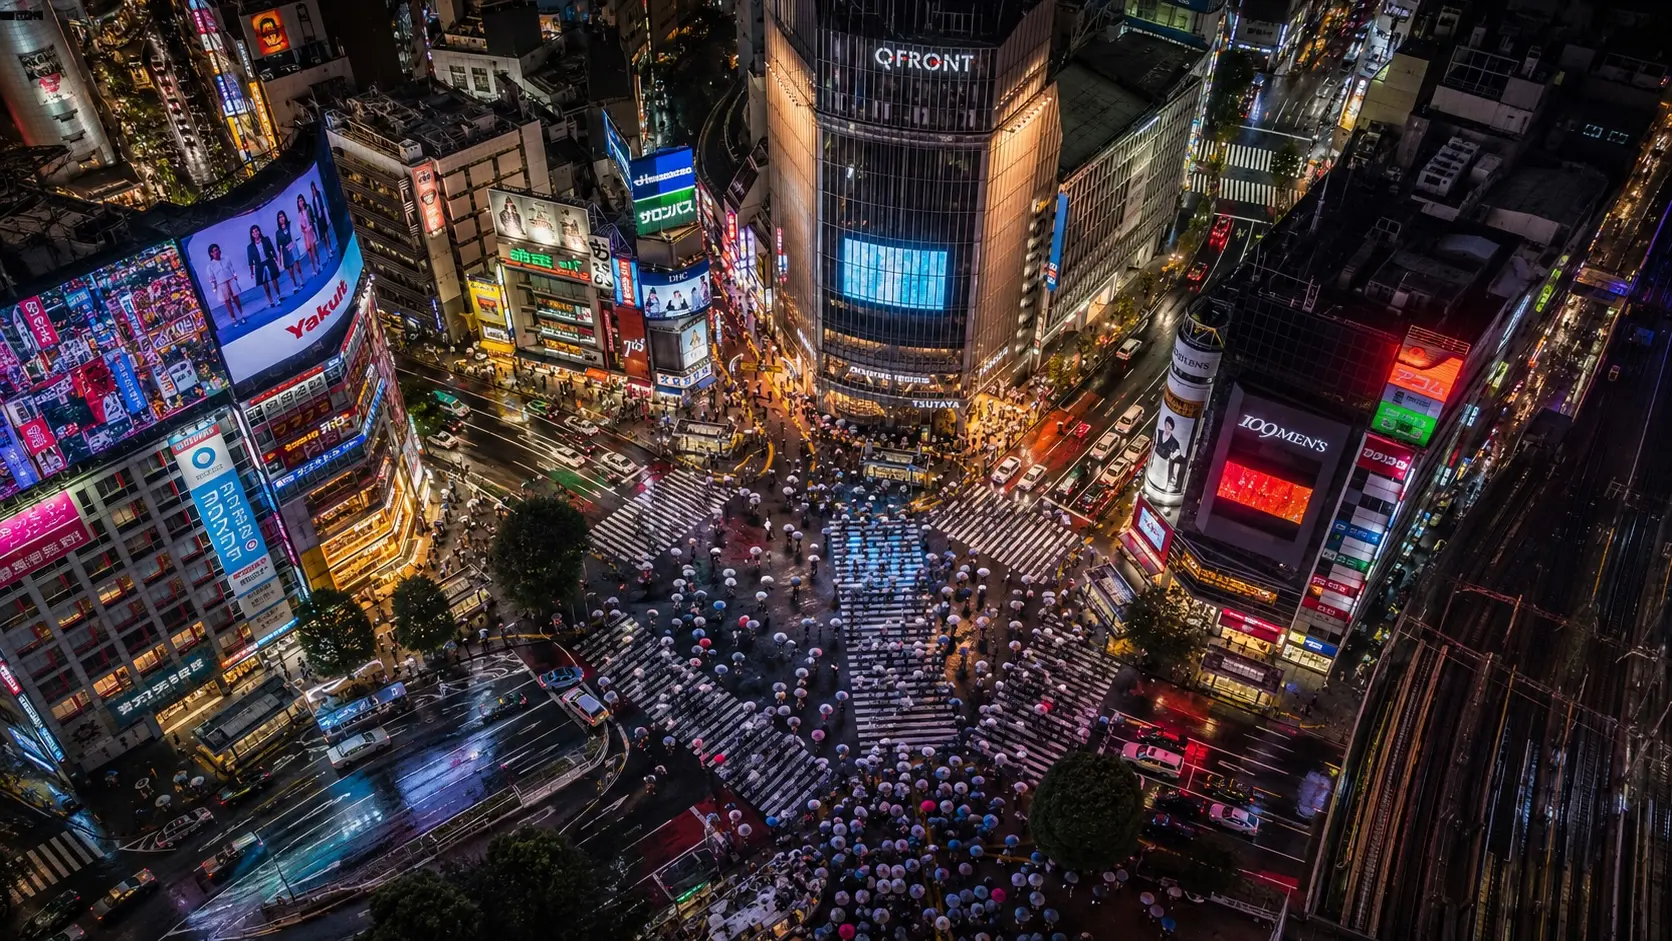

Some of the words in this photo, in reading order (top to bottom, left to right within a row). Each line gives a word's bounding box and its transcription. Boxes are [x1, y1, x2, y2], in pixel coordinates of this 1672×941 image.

[875, 47, 974, 72] QFRONT
[668, 271, 688, 283] DHC
[285, 280, 347, 339] Yakult
[1396, 368, 1444, 395] アコム
[912, 400, 960, 409] TSUTAYA
